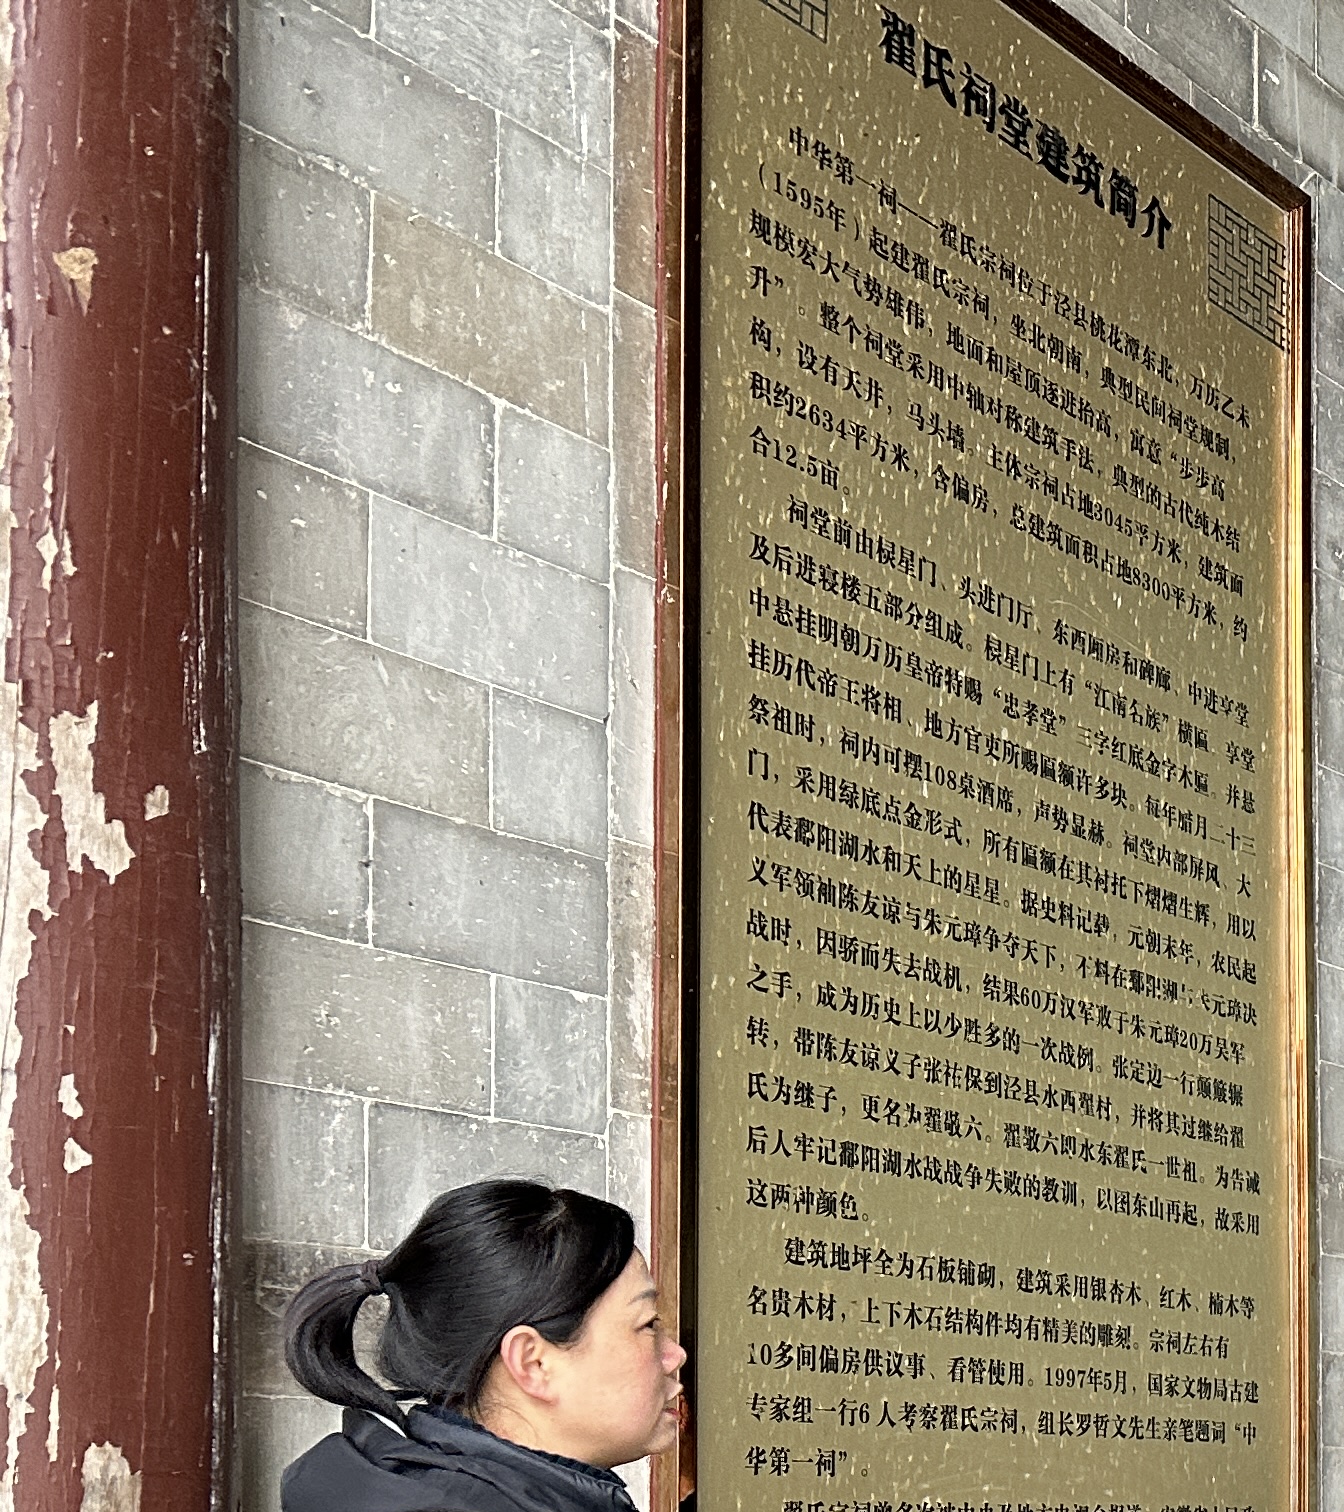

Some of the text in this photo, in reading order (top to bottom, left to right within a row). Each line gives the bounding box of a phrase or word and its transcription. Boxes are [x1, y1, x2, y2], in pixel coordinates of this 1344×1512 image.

[879, 5, 1172, 250] 翟氏祠堂建筑简介
[749, 425, 851, 495] 合12.5亩。
[745, 1178, 870, 1221] 这两种颜色。
